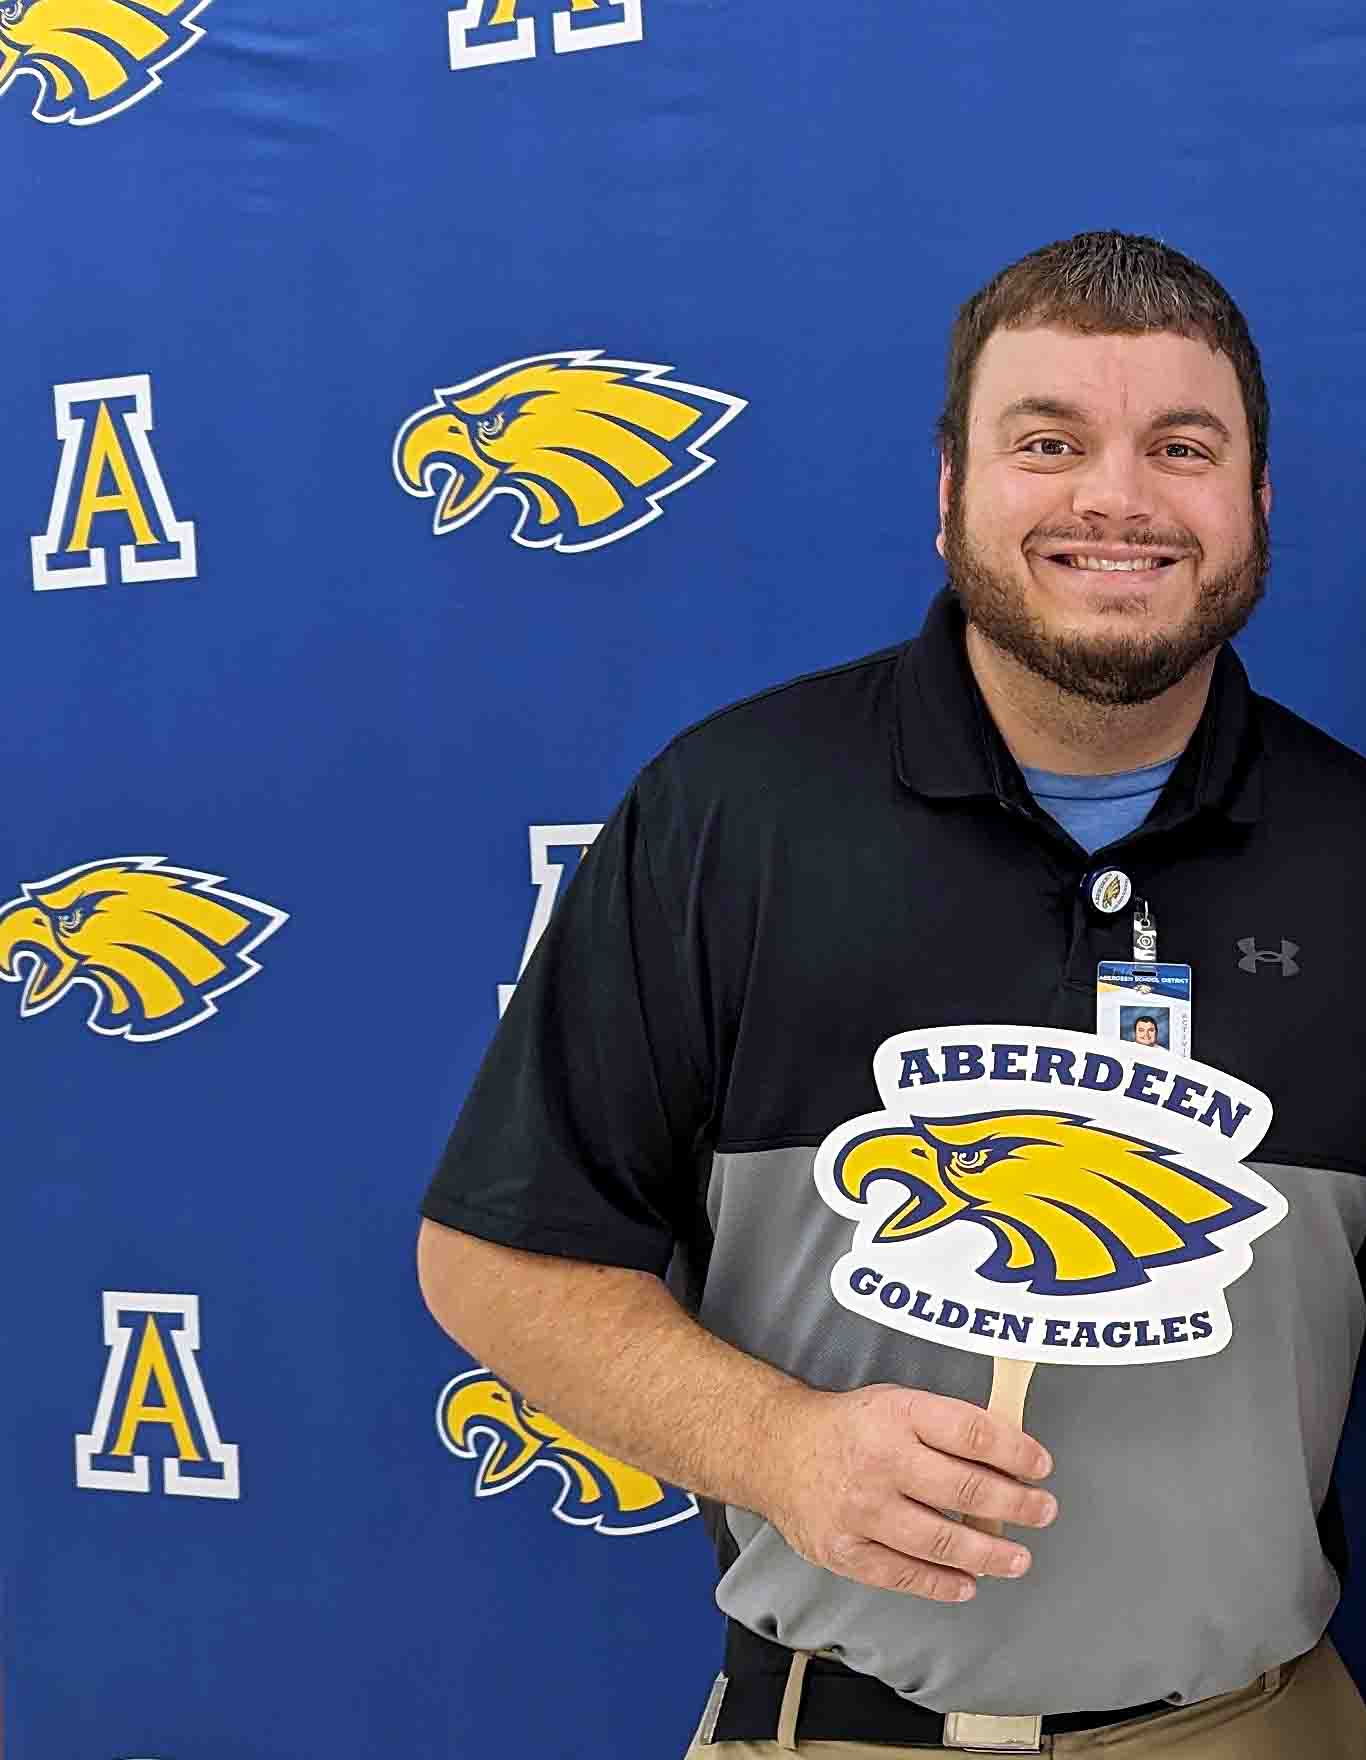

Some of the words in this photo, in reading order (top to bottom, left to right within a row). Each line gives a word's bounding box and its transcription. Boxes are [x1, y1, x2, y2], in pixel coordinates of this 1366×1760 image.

[31, 374, 197, 591] A
[898, 1043, 1251, 1138] ABERDEEN
[848, 1266, 1033, 1347] GOLDEN
[1042, 1311, 1213, 1348] EAGLES
[75, 1290, 240, 1499] A
